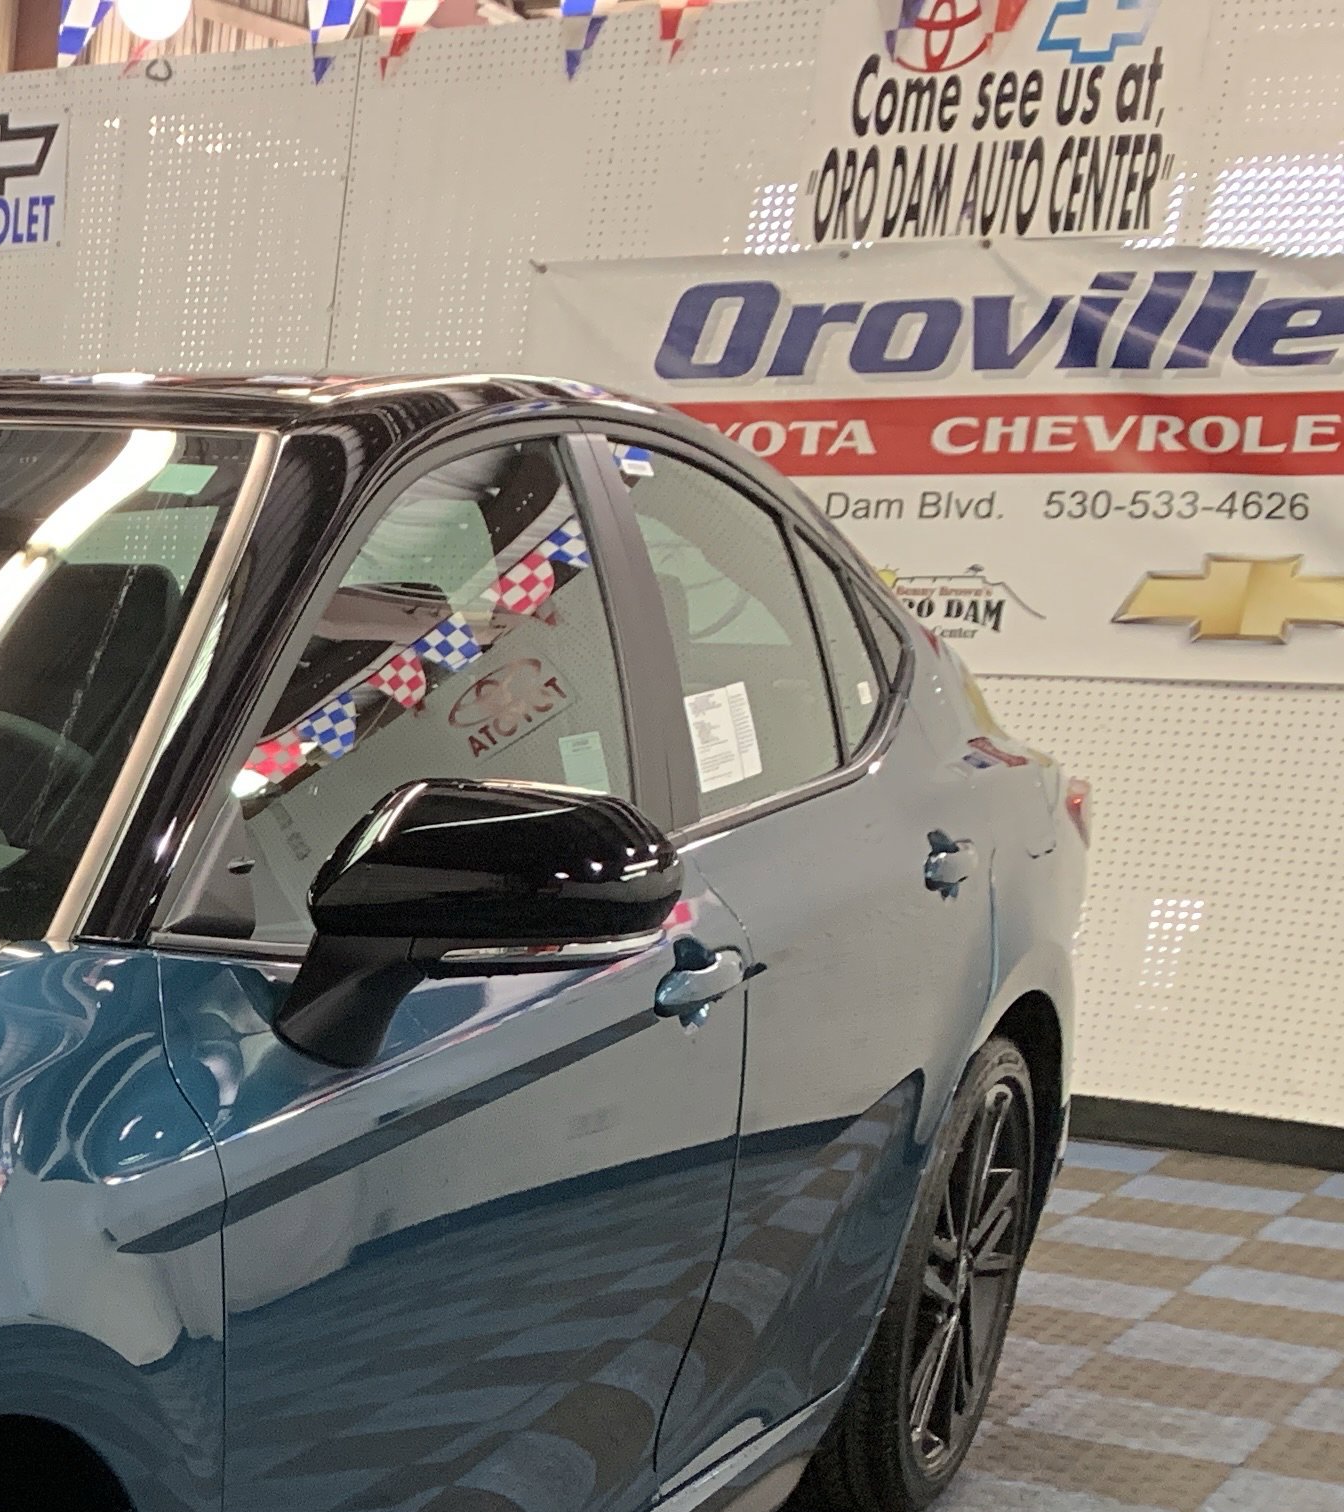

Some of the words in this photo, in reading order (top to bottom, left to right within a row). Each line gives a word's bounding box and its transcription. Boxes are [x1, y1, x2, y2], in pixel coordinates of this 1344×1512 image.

[852, 54, 962, 137] Come
[972, 67, 1043, 132] see
[1056, 63, 1102, 127] us
[1117, 46, 1165, 128] at,
[806, 145, 881, 243] "ORO
[881, 143, 958, 239] DAM
[958, 136, 1045, 237] AUTO
[1049, 133, 1176, 234] CENTER"
[654, 269, 1344, 381] Oroville
[703, 420, 878, 457] OTA
[931, 413, 1344, 455] CHEVROLE
[825, 491, 905, 520] Dam
[917, 489, 1004, 521] Blvd.
[1043, 489, 1310, 522] 530-533-4626
[932, 625, 979, 639] Center
[944, 599, 1007, 633] DAM
